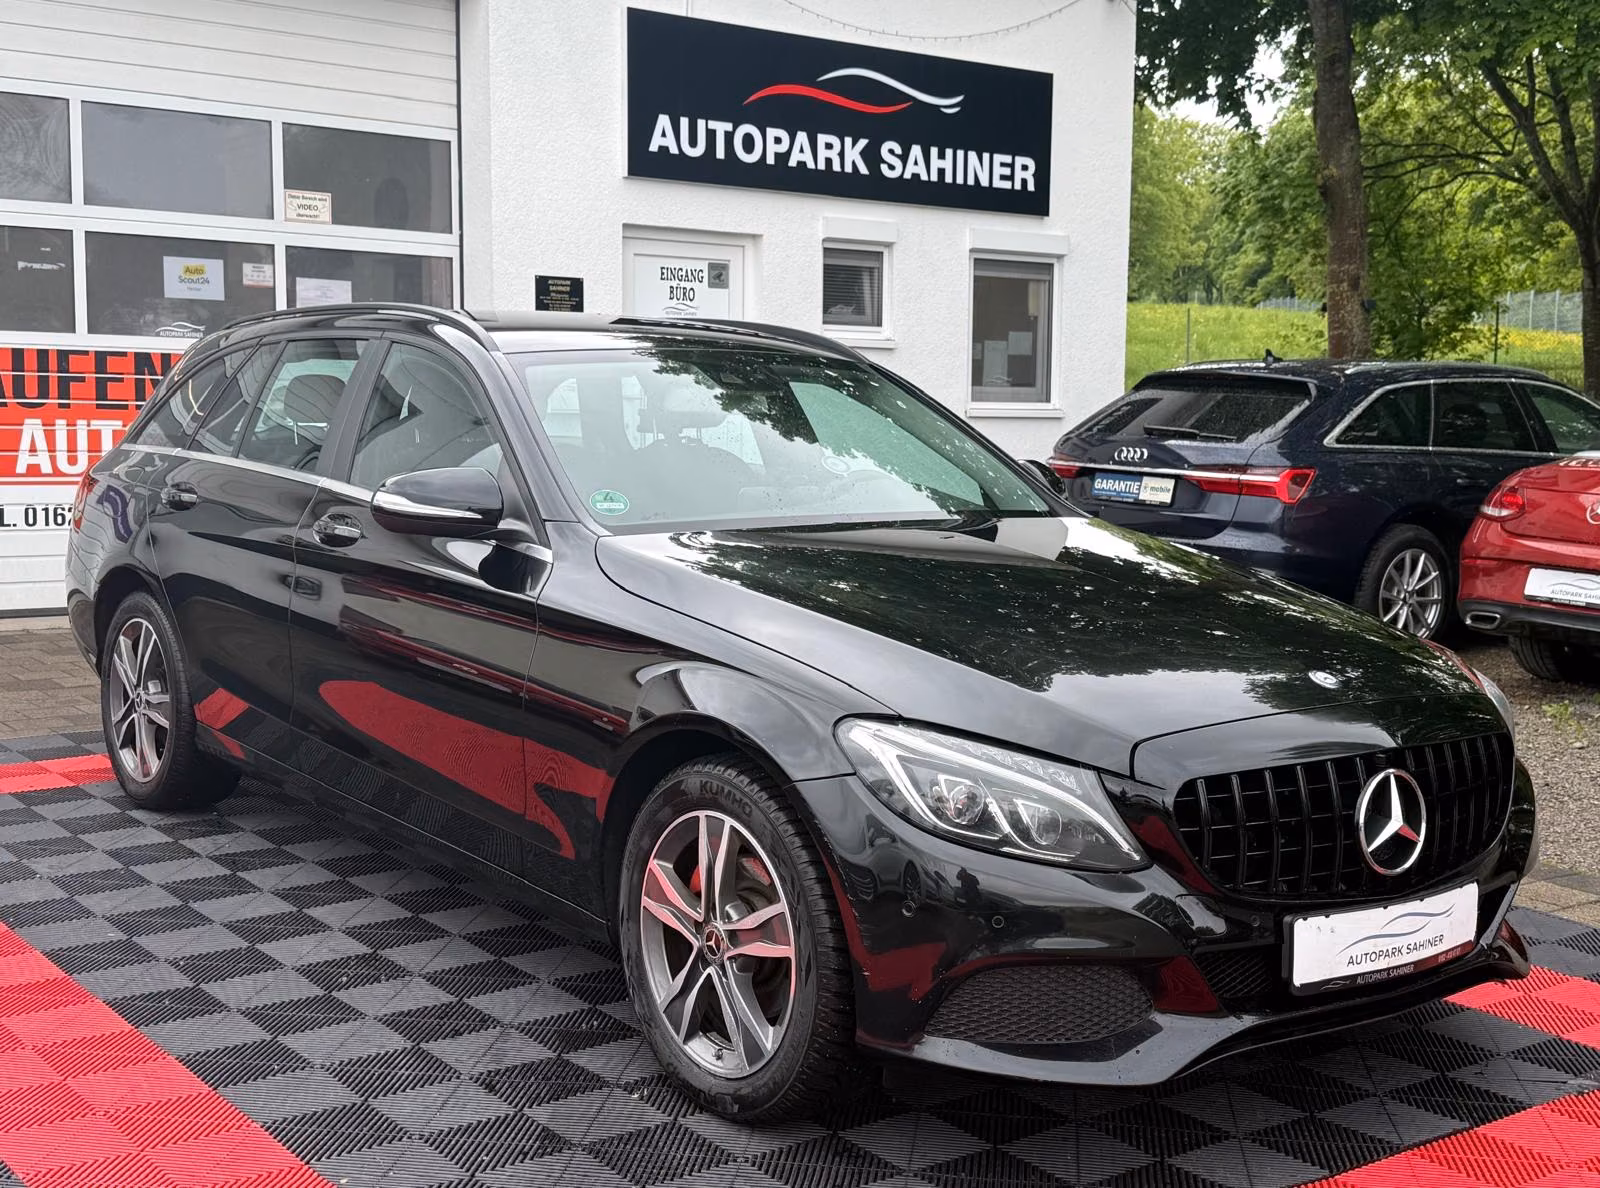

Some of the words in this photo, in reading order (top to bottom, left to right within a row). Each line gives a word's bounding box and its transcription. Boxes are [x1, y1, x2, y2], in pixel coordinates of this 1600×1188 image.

[648, 113, 870, 175] AUTOPARK
[880, 140, 1036, 192] SAHINER
[296, 203, 319, 212] VIDEO
[185, 265, 205, 275] Auto
[660, 266, 704, 284] EINGANG
[178, 275, 210, 285] Scout24
[669, 283, 696, 302] BÜRO
[0, 347, 172, 412] UFEN
[1095, 478, 1140, 494] GARANTIE
[1149, 485, 1171, 494] mobile
[1550, 588, 1583, 598] AUTOPARK
[699, 779, 753, 818] KUMHO
[1346, 944, 1404, 967] AUTOPARK
[1405, 934, 1445, 956] SAHINER
[1356, 970, 1388, 985] AUTOPARK
[1388, 964, 1415, 977] SAHINER
